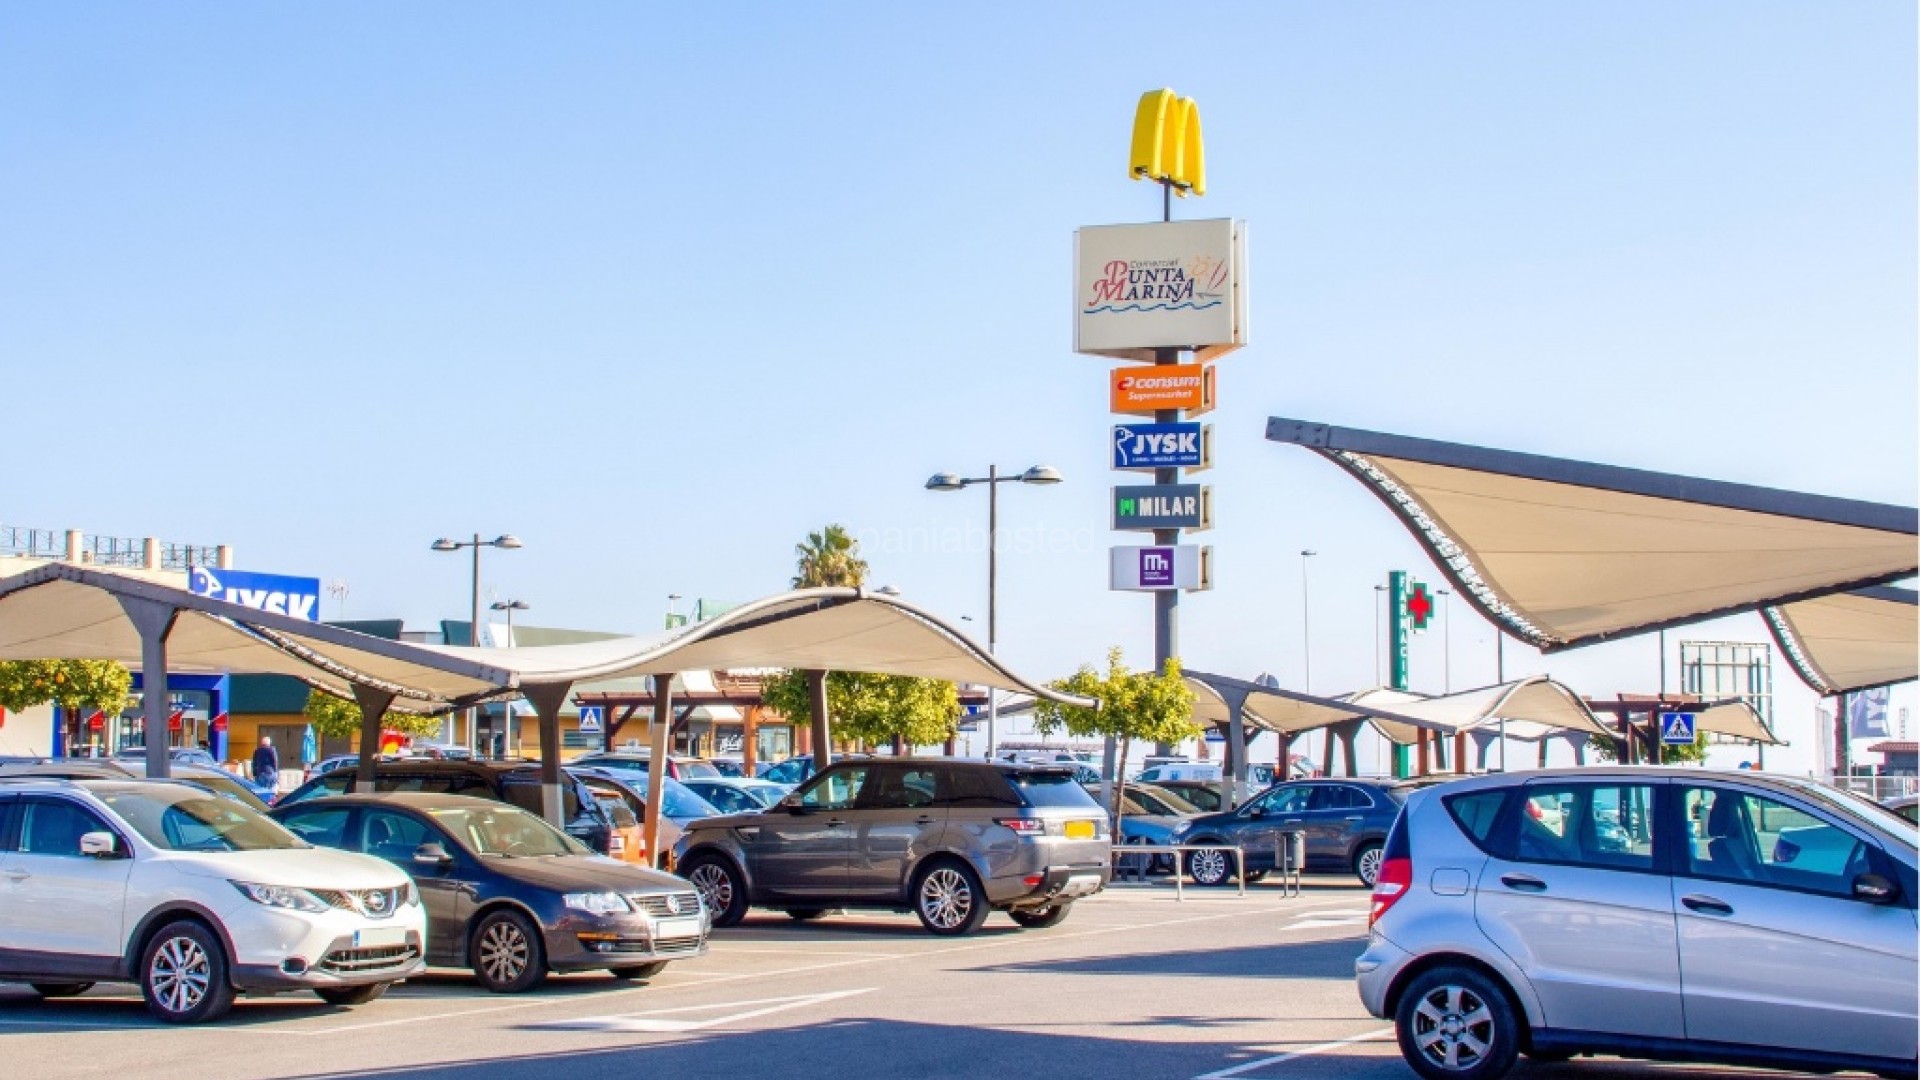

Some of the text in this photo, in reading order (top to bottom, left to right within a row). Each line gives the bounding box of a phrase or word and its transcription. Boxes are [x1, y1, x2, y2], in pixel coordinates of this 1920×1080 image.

[1104, 260, 1186, 285] PUNTA
[1088, 278, 1194, 306] MARINA
[1135, 376, 1200, 389] consum
[1128, 390, 1193, 402] Supermarket
[1132, 433, 1198, 455] JYSK
[1139, 496, 1197, 517] MILAR
